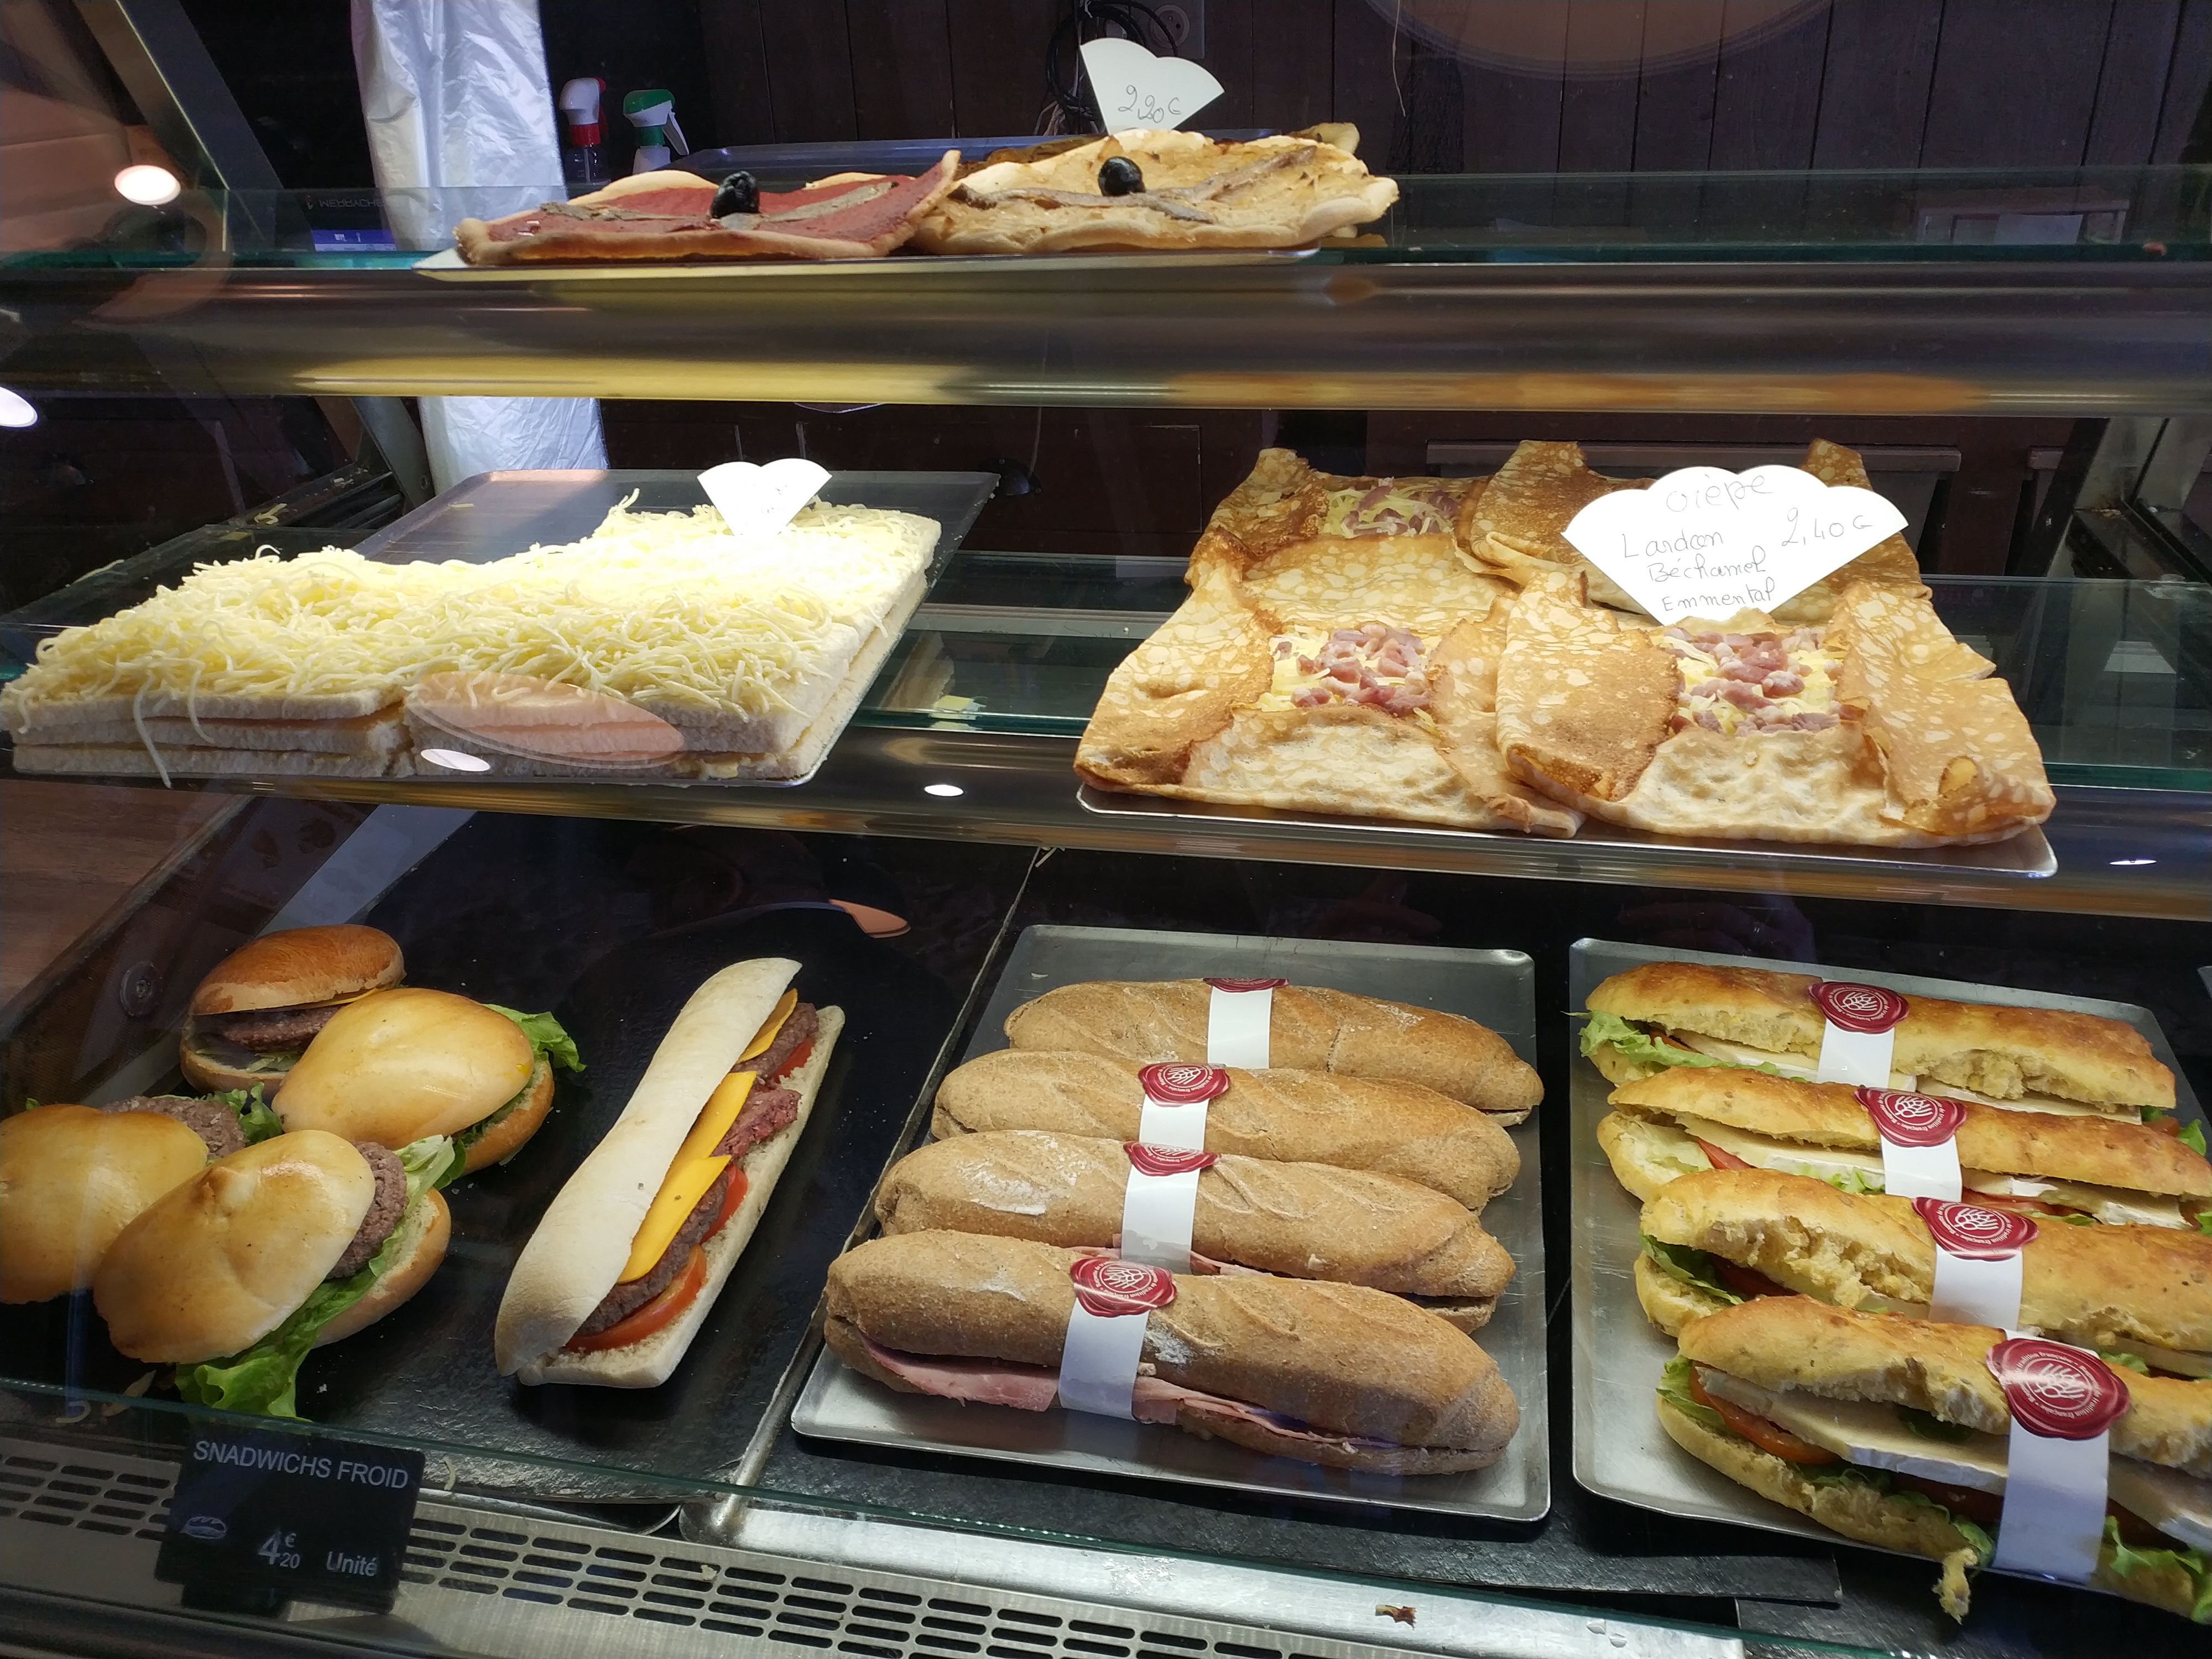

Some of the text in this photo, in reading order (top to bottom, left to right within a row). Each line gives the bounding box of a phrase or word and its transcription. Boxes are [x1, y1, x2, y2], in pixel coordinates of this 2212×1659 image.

[1622, 529, 1724, 557] Lardon
[1647, 545, 1766, 582] Béchamel
[1662, 576, 1775, 611] Emmental
[193, 1440, 409, 1489] SNADWICHS FROID
[326, 1551, 378, 1577] Unité
